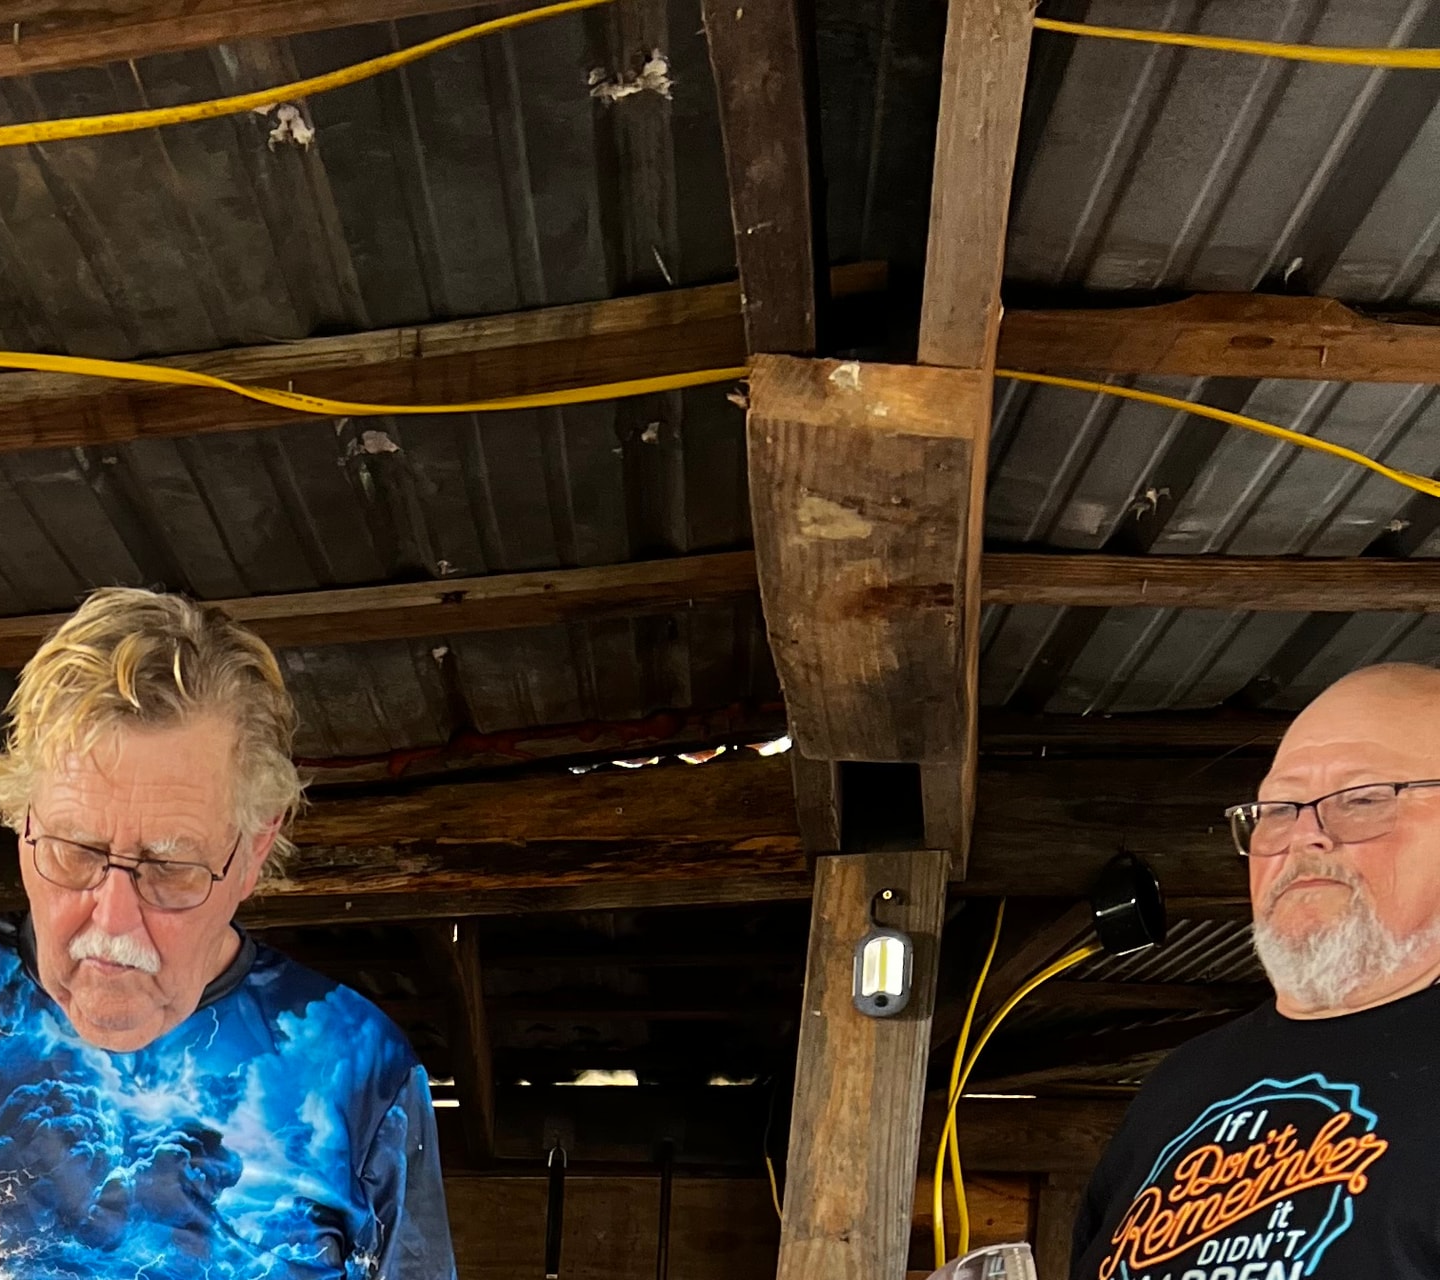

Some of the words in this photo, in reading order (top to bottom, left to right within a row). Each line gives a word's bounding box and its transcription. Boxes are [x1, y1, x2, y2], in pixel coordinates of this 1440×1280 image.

[1214, 1112, 1251, 1143] If
[1247, 1109, 1269, 1141] I
[1168, 1123, 1301, 1201] Don't
[1267, 1200, 1296, 1230] it
[1197, 1230, 1307, 1266] DIDN'T
